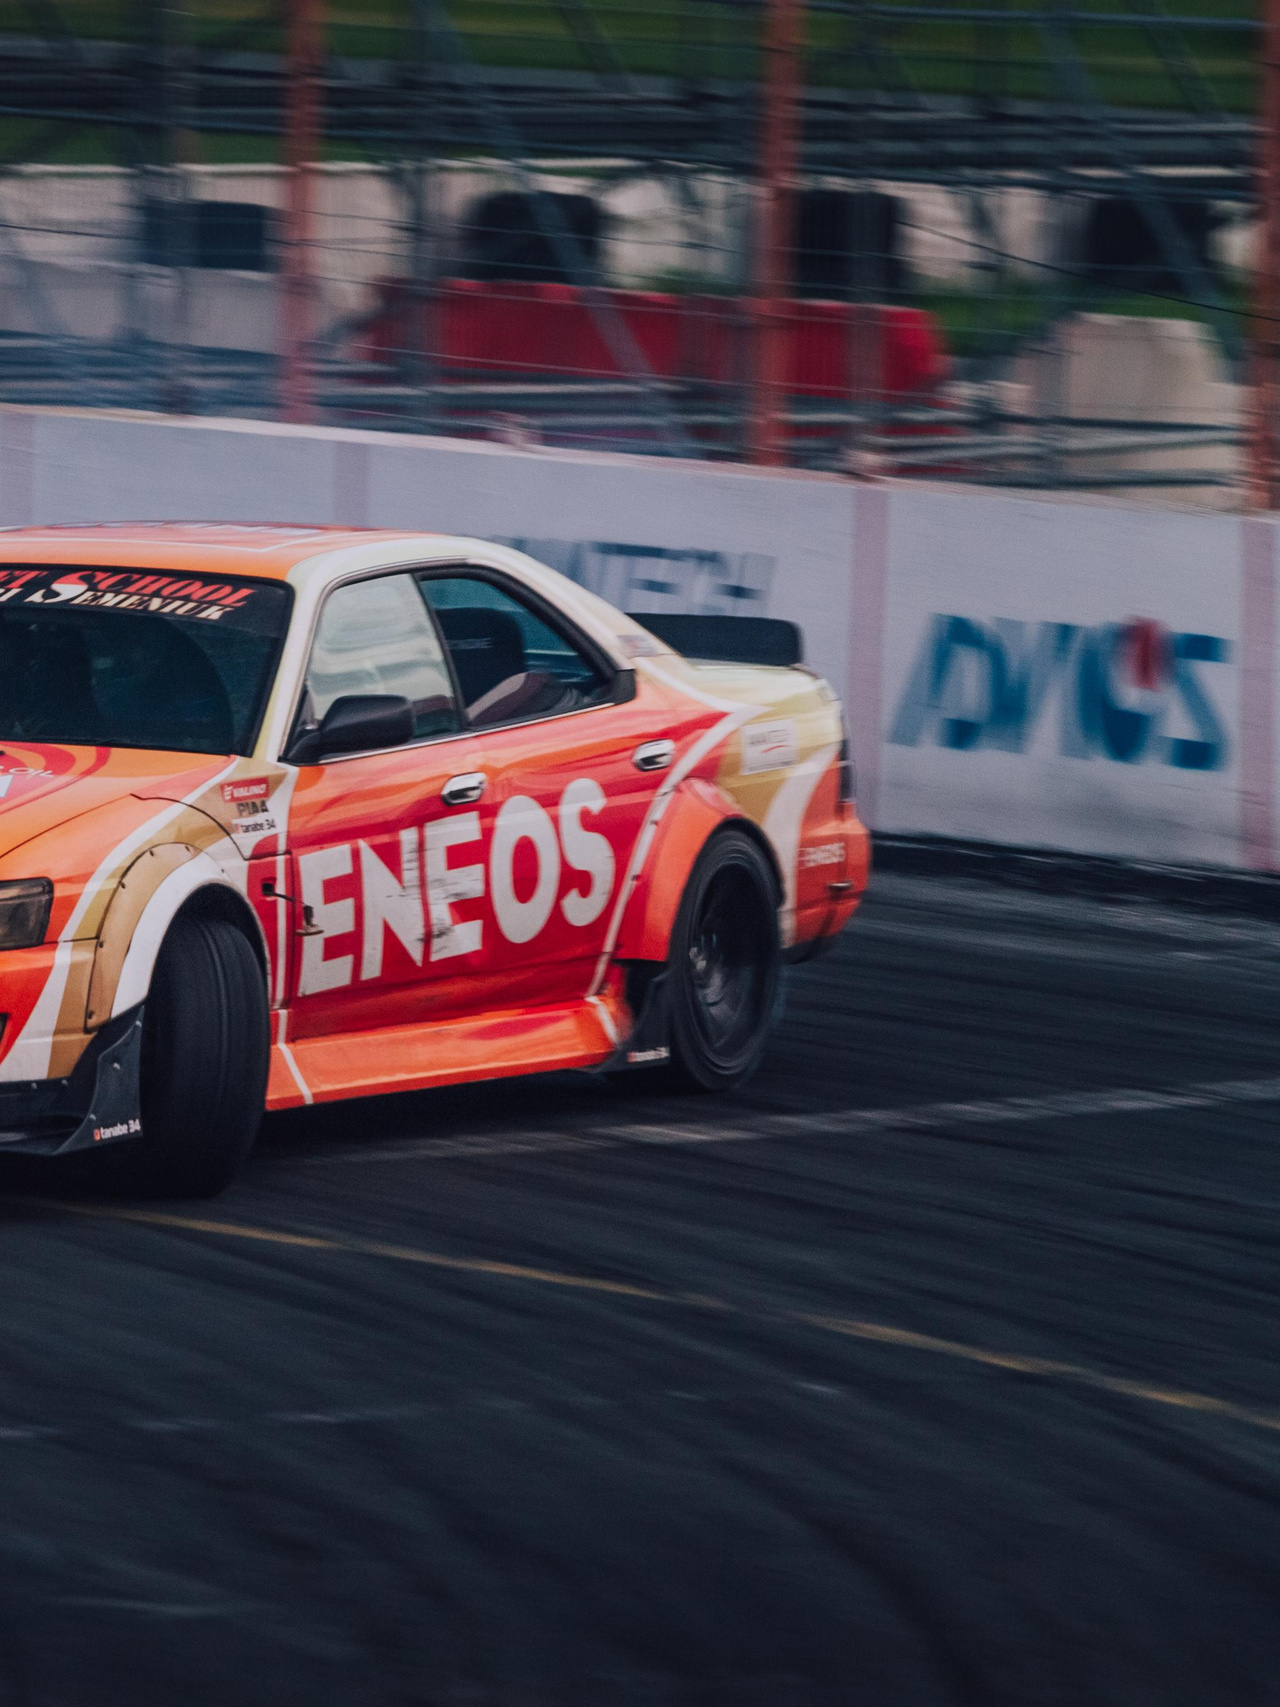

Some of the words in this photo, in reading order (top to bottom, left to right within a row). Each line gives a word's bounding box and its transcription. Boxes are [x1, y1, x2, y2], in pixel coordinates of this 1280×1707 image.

[24, 578, 234, 620] SEMENIUK
[32, 571, 257, 607] SCHOOL
[9, 767, 54, 778] OIL
[236, 799, 269, 816] PIAA
[297, 778, 615, 997] ENEOS
[101, 1122, 128, 1139] tanabe
